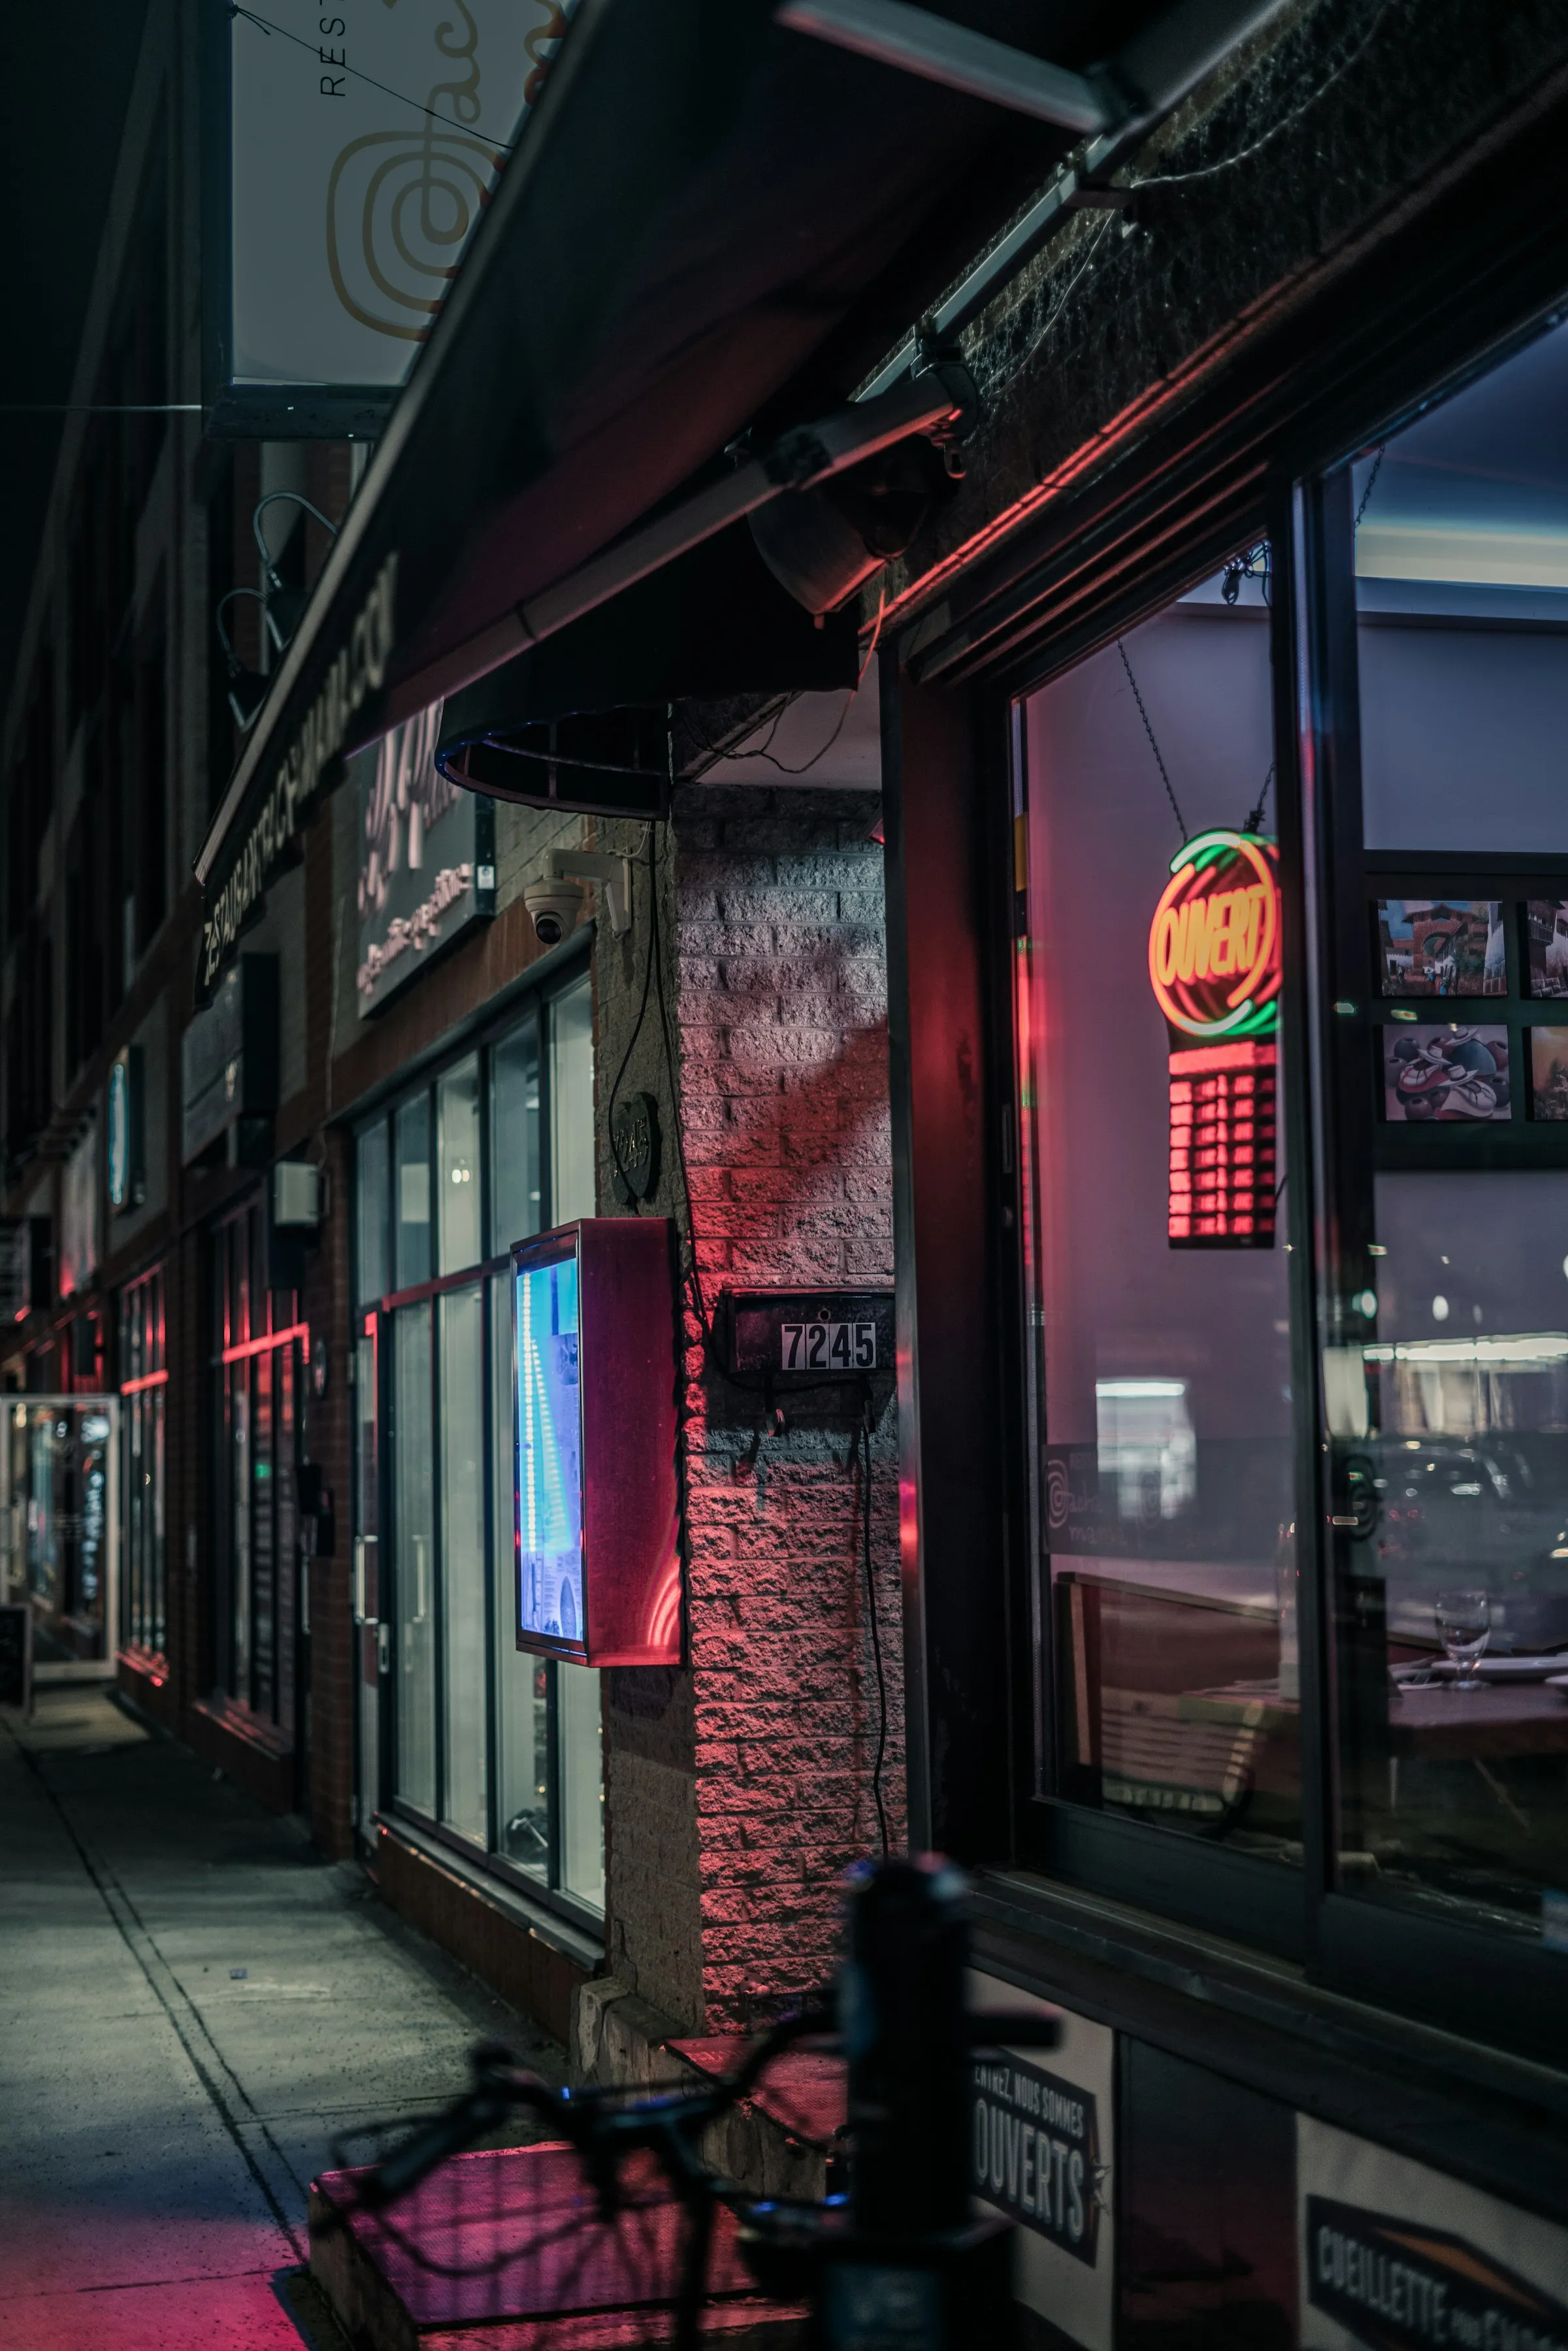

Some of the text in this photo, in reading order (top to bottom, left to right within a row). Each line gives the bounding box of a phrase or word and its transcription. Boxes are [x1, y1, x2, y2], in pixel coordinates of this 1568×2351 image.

[1156, 883, 1267, 986] OUVERT
[784, 1324, 874, 1368] 7245
[1014, 2071, 1041, 2116] NOUS
[1042, 2086, 1085, 2140] SOMMES
[972, 2096, 1085, 2244] OUVERTS
[1316, 2224, 1449, 2344] CUEILLETTE
